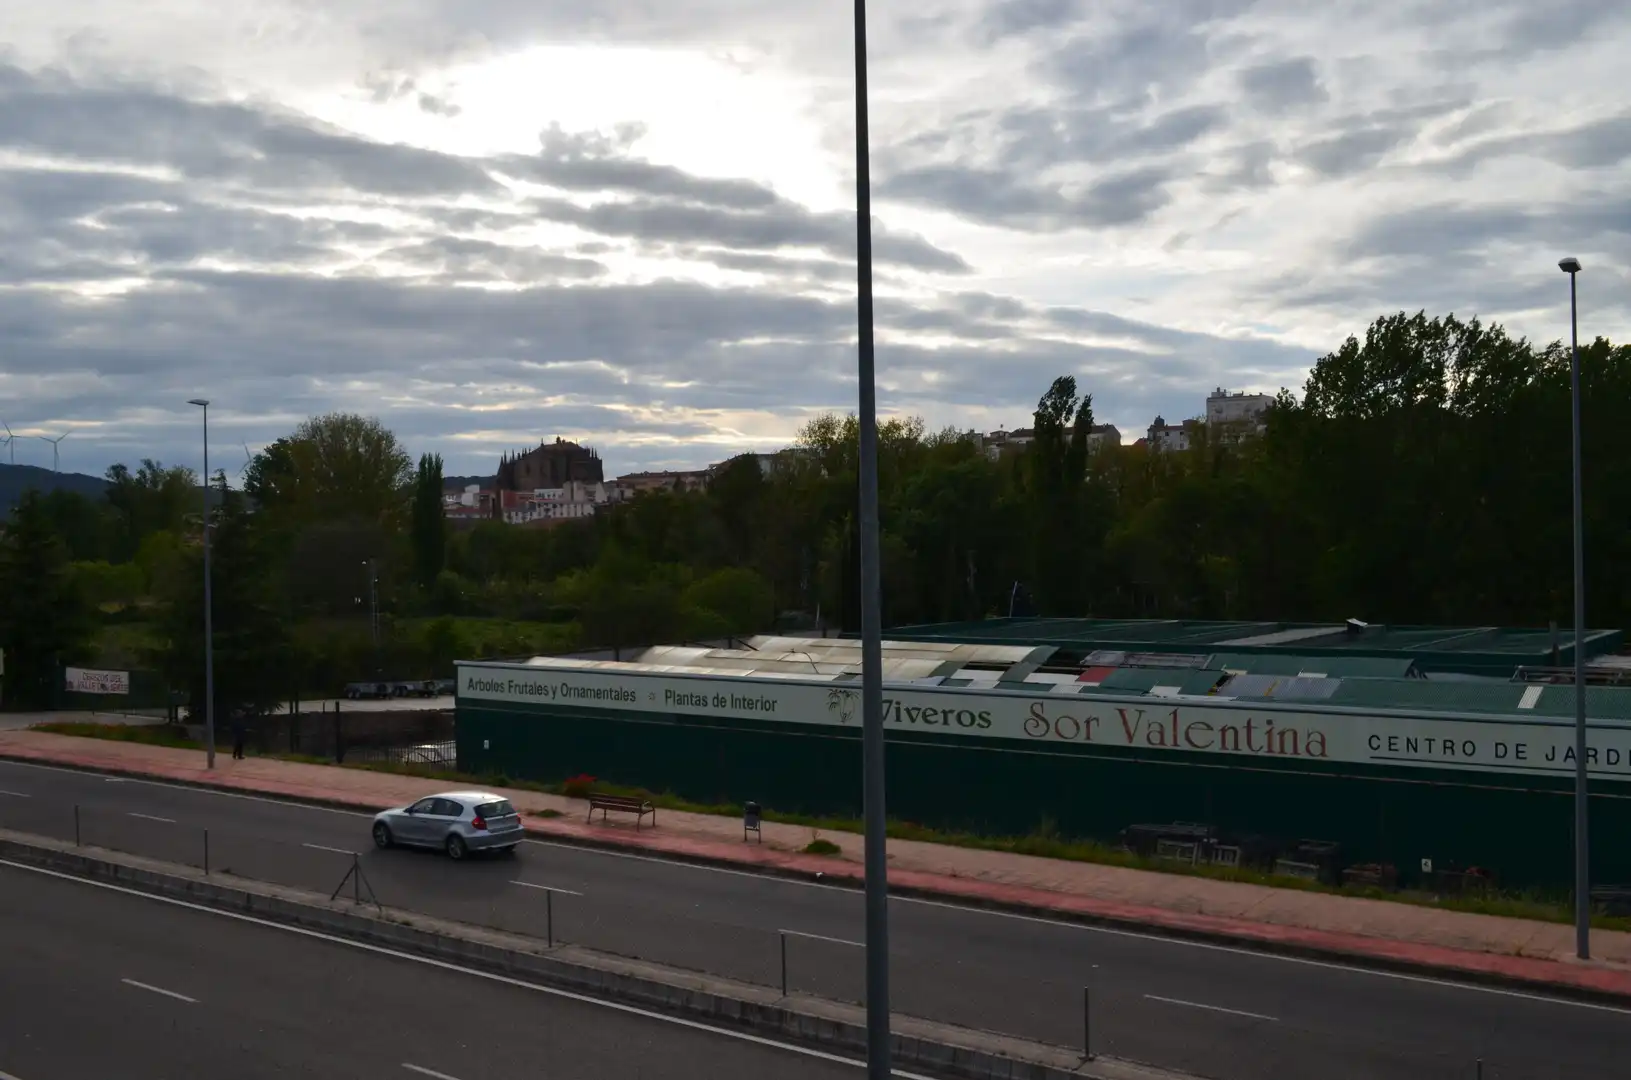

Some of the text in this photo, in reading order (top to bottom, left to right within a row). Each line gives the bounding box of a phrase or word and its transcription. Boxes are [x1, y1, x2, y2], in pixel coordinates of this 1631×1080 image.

[508, 679, 549, 697] Frutales
[550, 685, 558, 700] y
[559, 682, 637, 702] Ornamentales
[666, 690, 787, 714] Plantas de Interior
[1023, 701, 1099, 741] Sor
[1115, 707, 1329, 757] Valentina
[1368, 735, 1476, 756] CENTRO
[1495, 743, 1528, 760] DE
